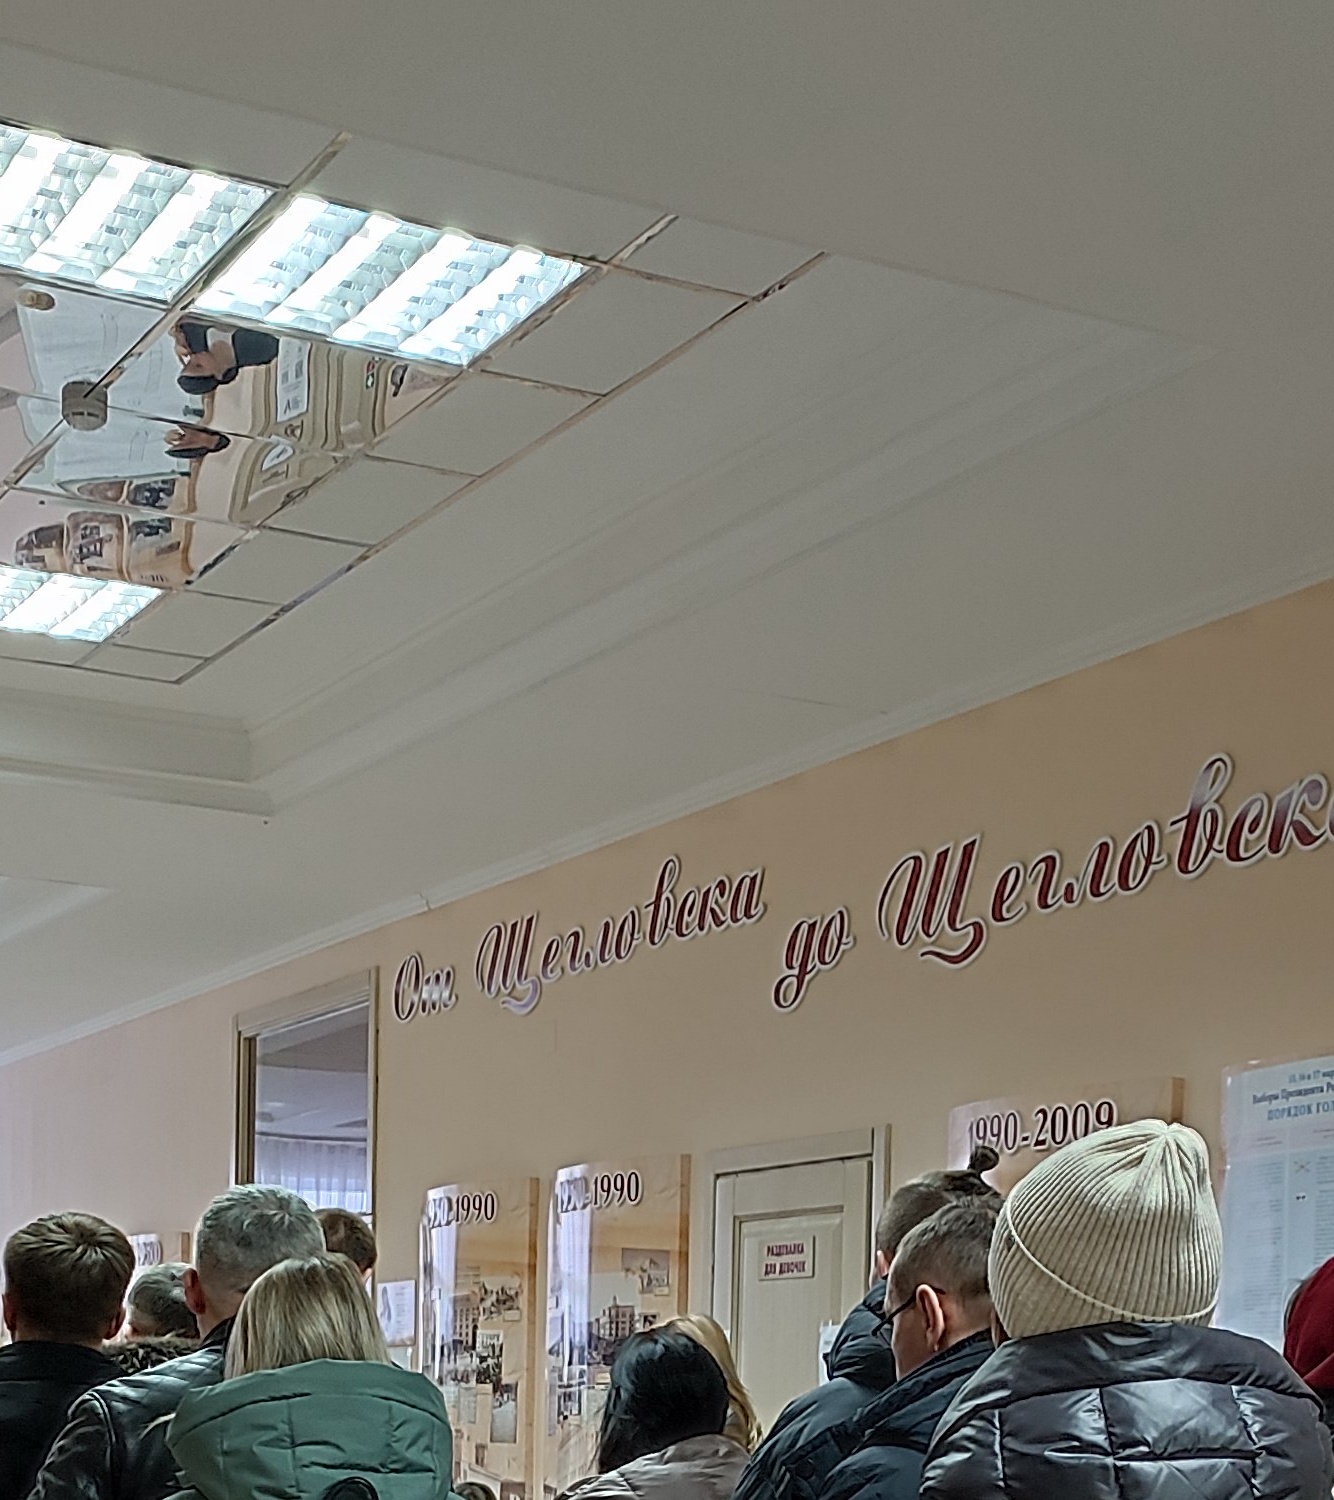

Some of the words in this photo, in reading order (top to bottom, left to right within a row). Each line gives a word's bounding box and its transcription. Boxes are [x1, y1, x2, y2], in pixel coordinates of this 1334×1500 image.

[394, 952, 457, 1022] От
[475, 855, 765, 1014] Щегловска
[773, 906, 854, 1012] до
[967, 1101, 1116, 1152] 1990-2009
[1268, 1102, 1312, 1120] ПОРЯДОК
